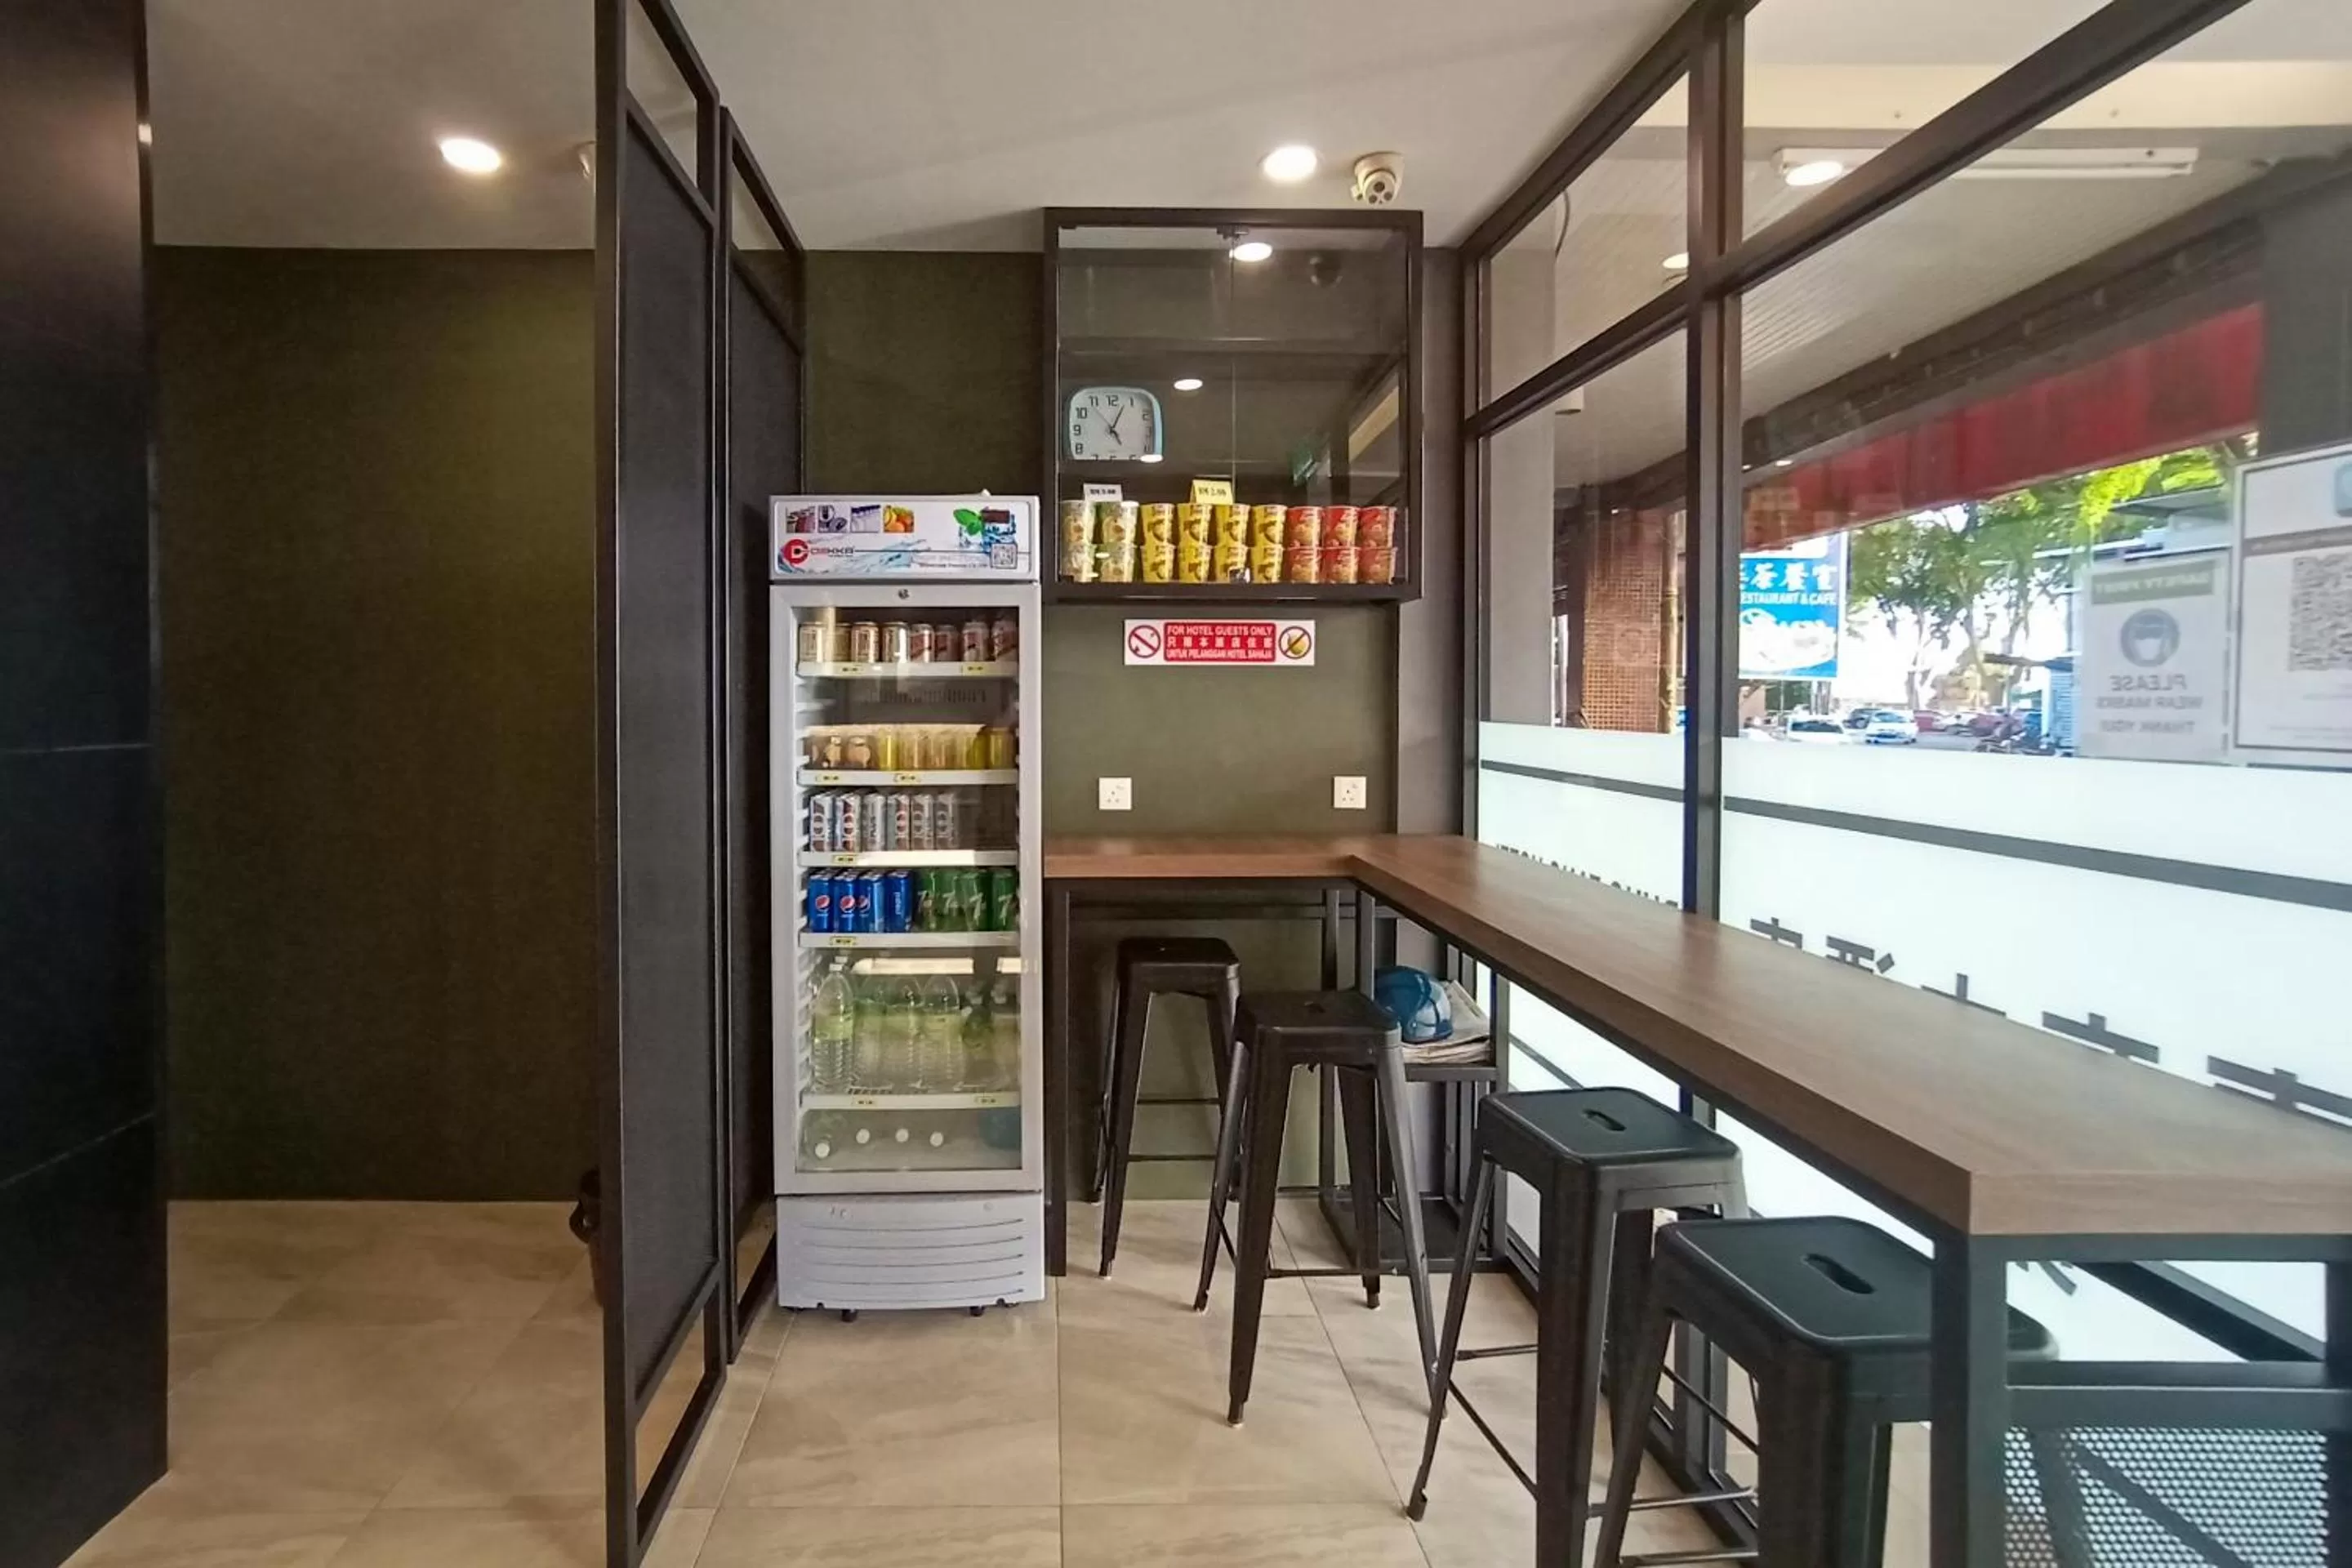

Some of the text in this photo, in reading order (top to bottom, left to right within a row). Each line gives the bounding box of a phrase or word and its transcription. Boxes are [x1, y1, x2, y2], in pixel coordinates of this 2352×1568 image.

[1089, 395, 1098, 407] 11
[1106, 394, 1119, 407] 12
[1076, 408, 1087, 419] 10
[1074, 425, 1081, 436] 9
[1076, 443, 1083, 455] 8
[1166, 625, 1184, 636] FOR
[1187, 625, 1214, 635] HOTEL
[1250, 625, 1273, 635] ONLY
